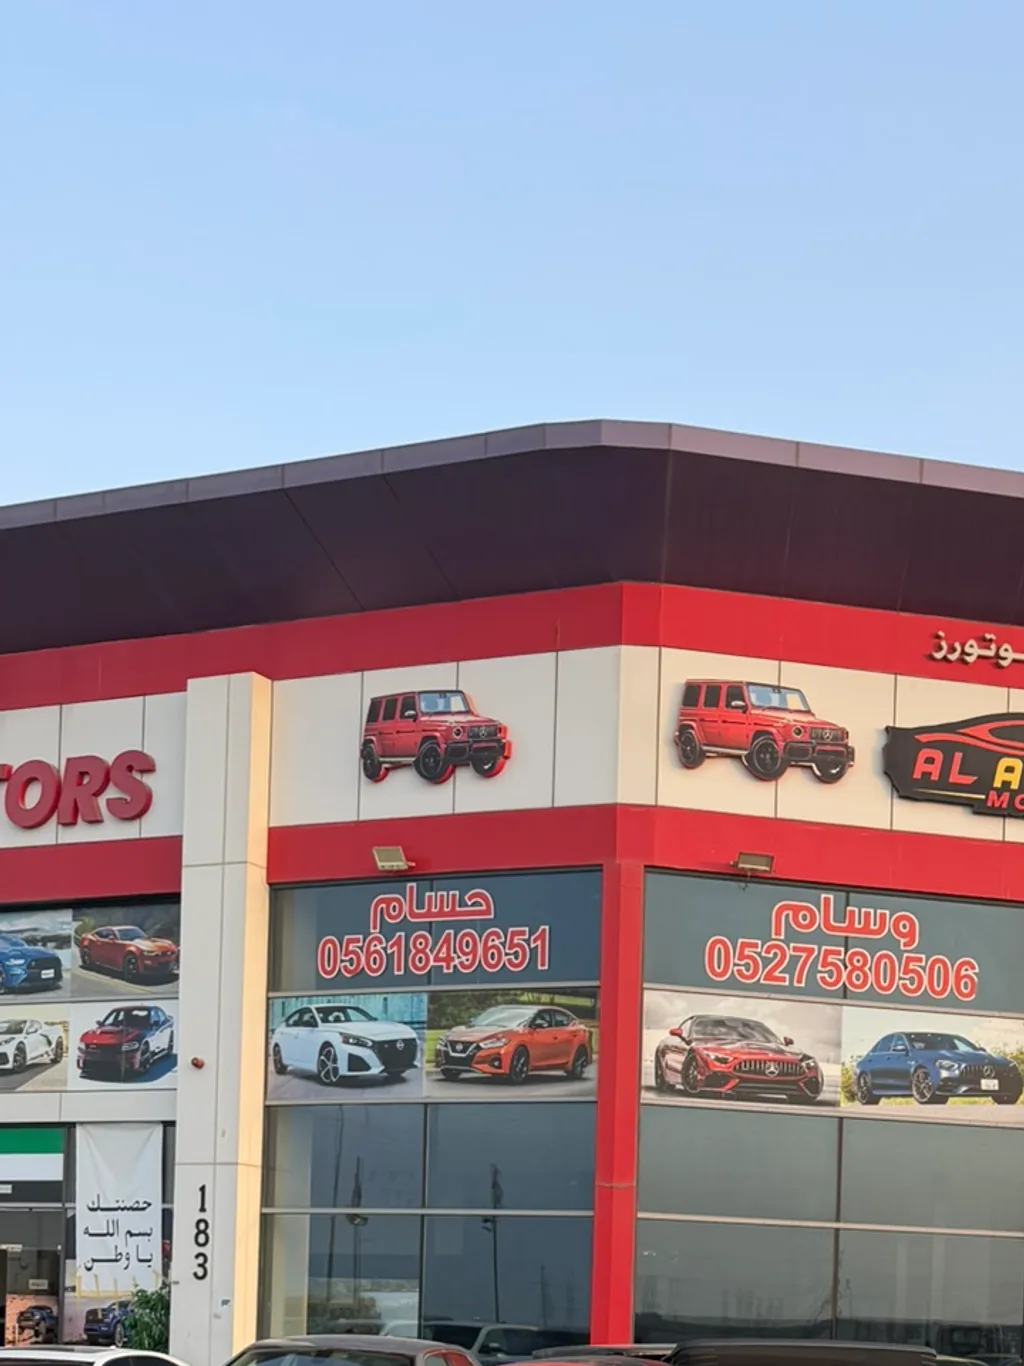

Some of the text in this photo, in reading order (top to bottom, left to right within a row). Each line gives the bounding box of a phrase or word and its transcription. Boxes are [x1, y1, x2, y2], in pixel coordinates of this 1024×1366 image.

[0, 749, 156, 829] ORS
[913, 748, 978, 784] AL
[370, 882, 494, 933] حسام
[771, 894, 919, 951] وسام
[317, 925, 550, 979] 0561849651
[704, 935, 980, 1001] 0527580506
[83, 1219, 153, 1247] بسم الله
[83, 1245, 153, 1272] يا وطن
